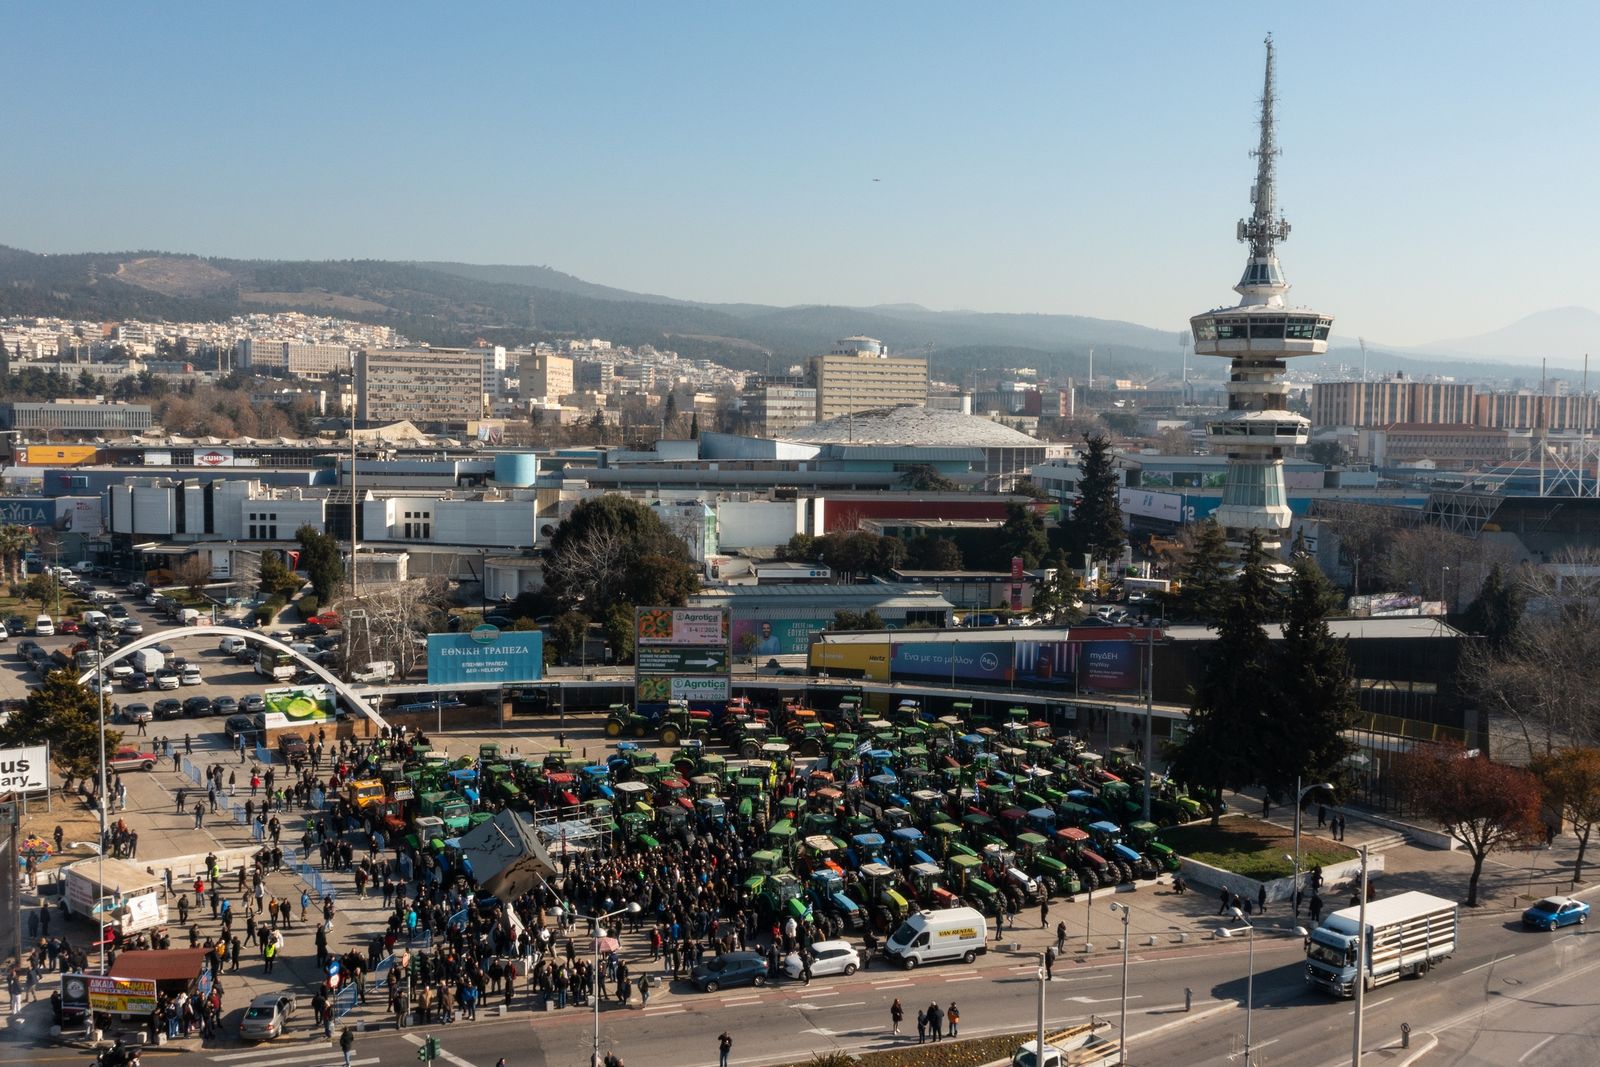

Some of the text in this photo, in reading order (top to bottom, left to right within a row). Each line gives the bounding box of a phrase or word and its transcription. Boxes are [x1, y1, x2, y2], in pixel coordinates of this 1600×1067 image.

[20, 452, 27, 462] 2
[1183, 505, 1195, 520] 12
[685, 614, 718, 623] Agrotica
[441, 646, 529, 656] ΕΘΝΙΚΗ ΤΡΑΠΕΖΑ
[684, 679, 726, 689] Agrotica
[1, 760, 30, 774] us
[1, 775, 29, 787] ary
